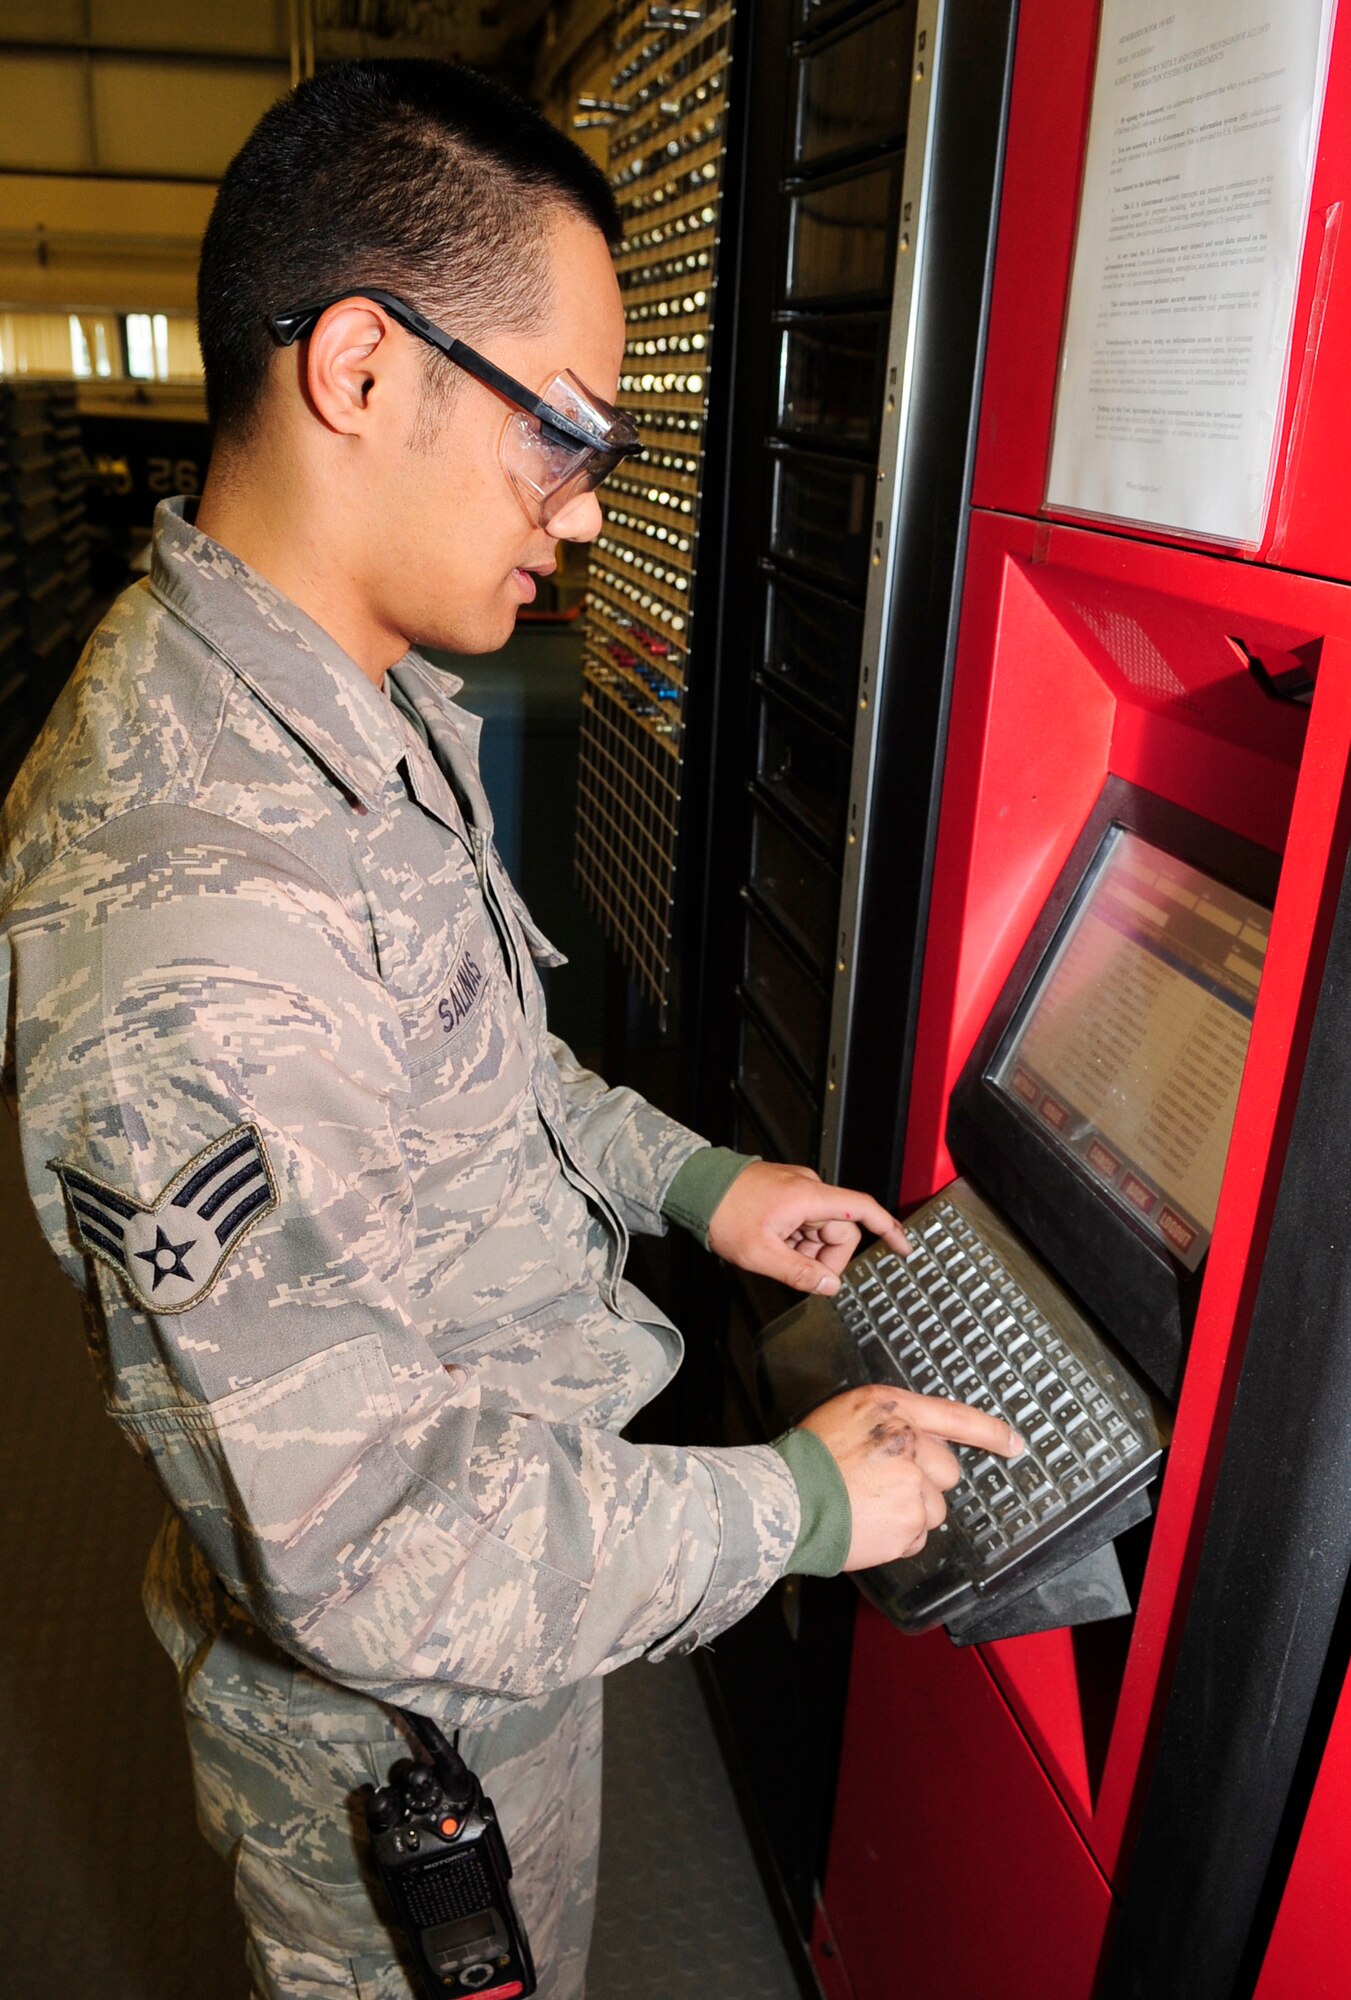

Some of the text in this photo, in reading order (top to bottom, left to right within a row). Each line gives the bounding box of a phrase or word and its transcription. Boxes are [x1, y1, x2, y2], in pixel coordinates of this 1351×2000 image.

[438, 951, 482, 1032] SALINAS
[1159, 1211, 1192, 1248] LOGOUT
[423, 1847, 477, 1870] MOTOROLA
